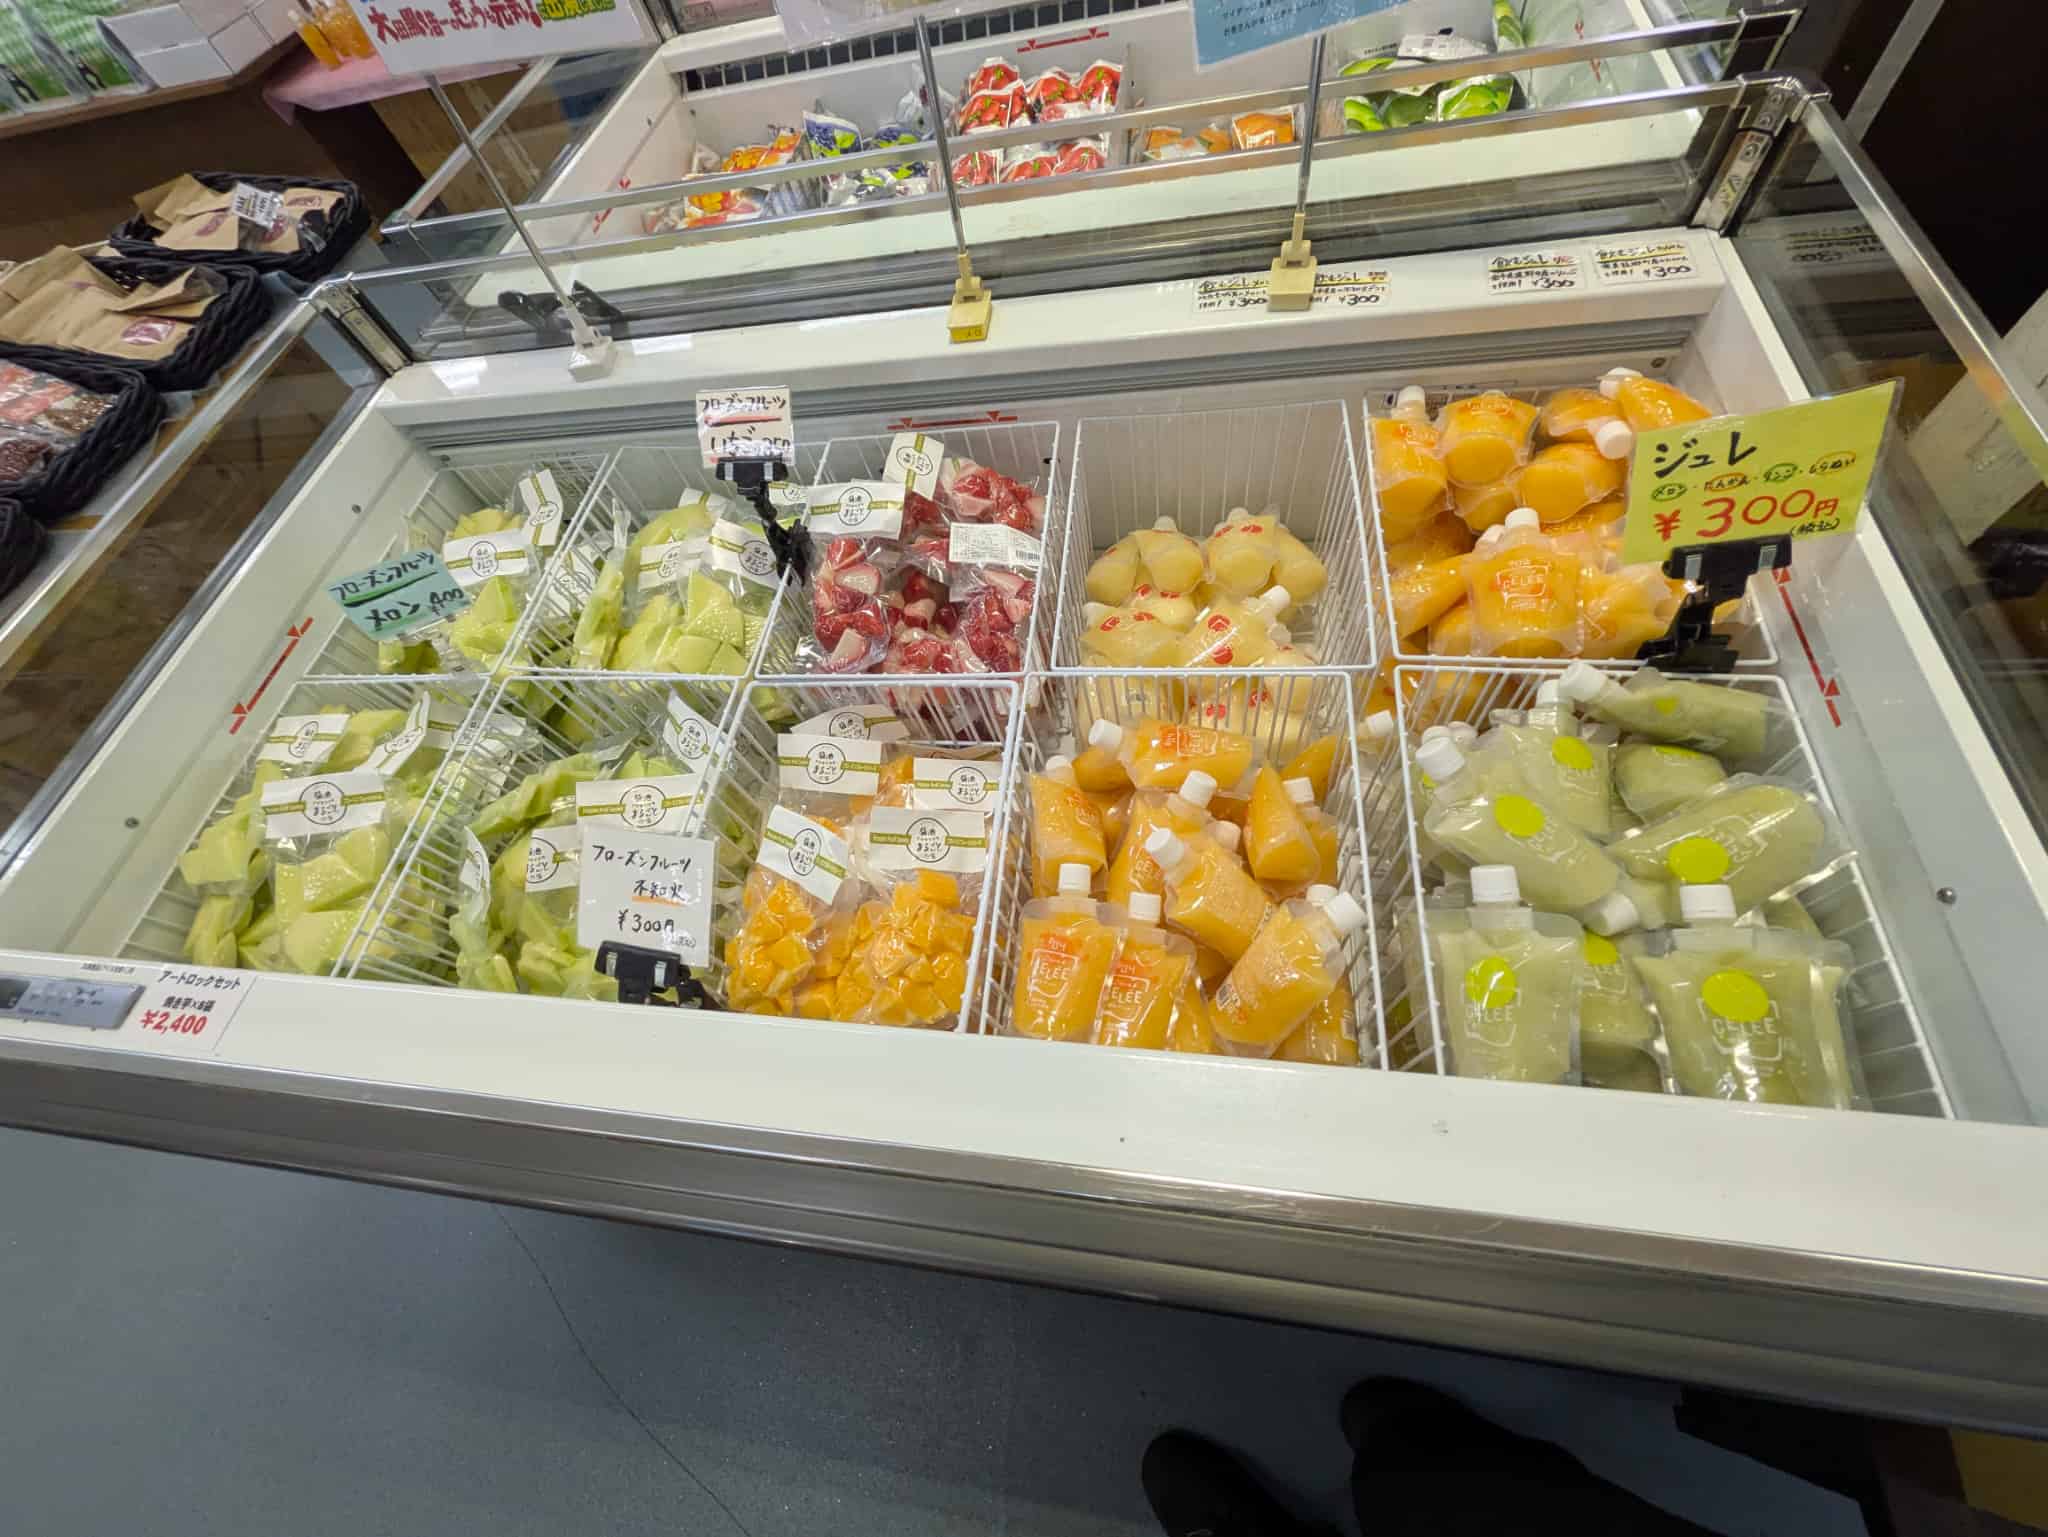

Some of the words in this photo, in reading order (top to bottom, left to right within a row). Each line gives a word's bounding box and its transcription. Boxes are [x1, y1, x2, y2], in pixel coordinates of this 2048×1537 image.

[1653, 431, 1758, 479] ジュレ
[329, 551, 435, 600] フローズンフルーツ
[364, 601, 421, 631] メロン
[592, 844, 692, 873] フローズンフルーツ
[633, 880, 685, 900] 不知火
[157, 970, 241, 991] アートロックセット
[140, 1009, 208, 1036] ¥2,400
